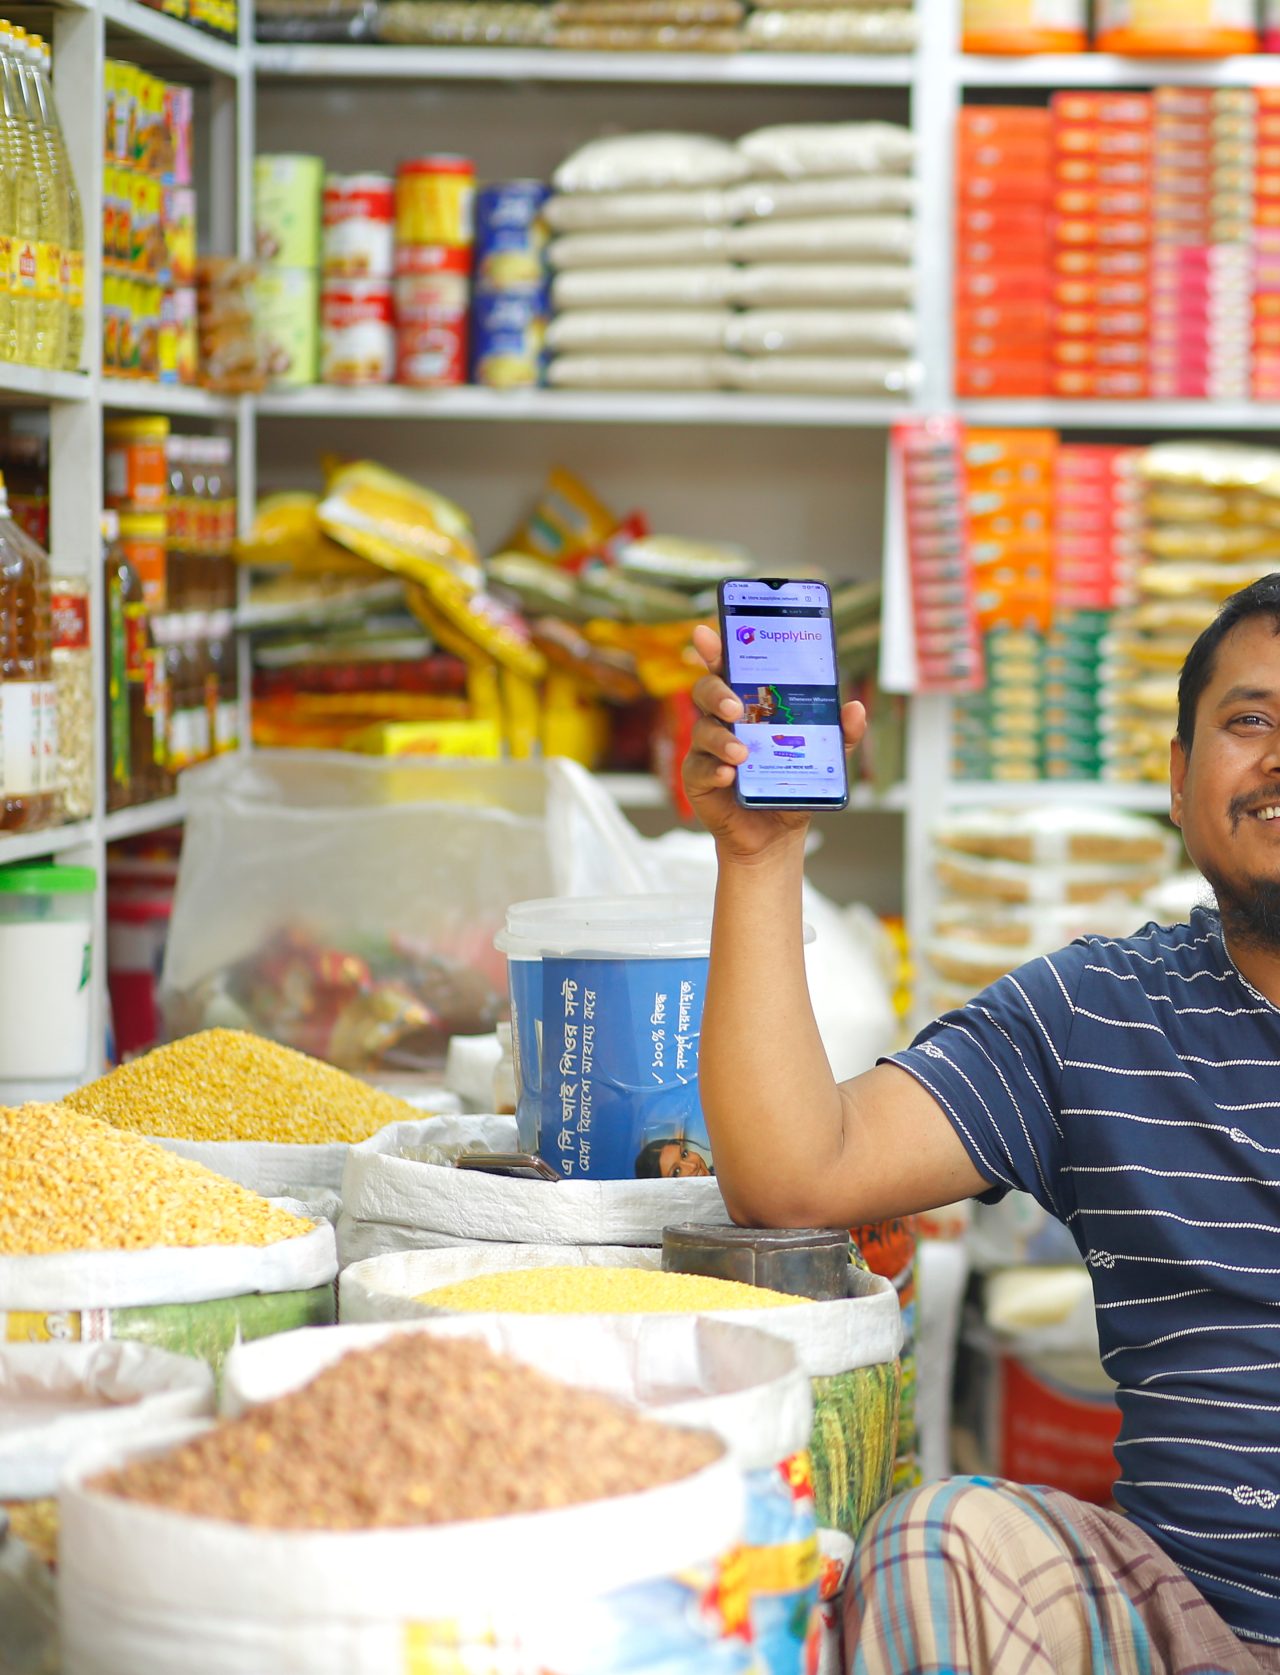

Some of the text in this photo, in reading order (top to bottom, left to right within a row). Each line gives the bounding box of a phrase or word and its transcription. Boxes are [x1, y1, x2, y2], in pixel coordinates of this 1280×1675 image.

[760, 630, 822, 643] SupplyLine
[651, 992, 668, 1068] ১০০% বিশুদ্ধ
[673, 1033, 692, 1070] সম্পূর্ণ
[558, 978, 579, 1175] এ সি আই পিওর সল্ট
[577, 987, 597, 1171] মেধা বিকাশে সাহায্য করে
